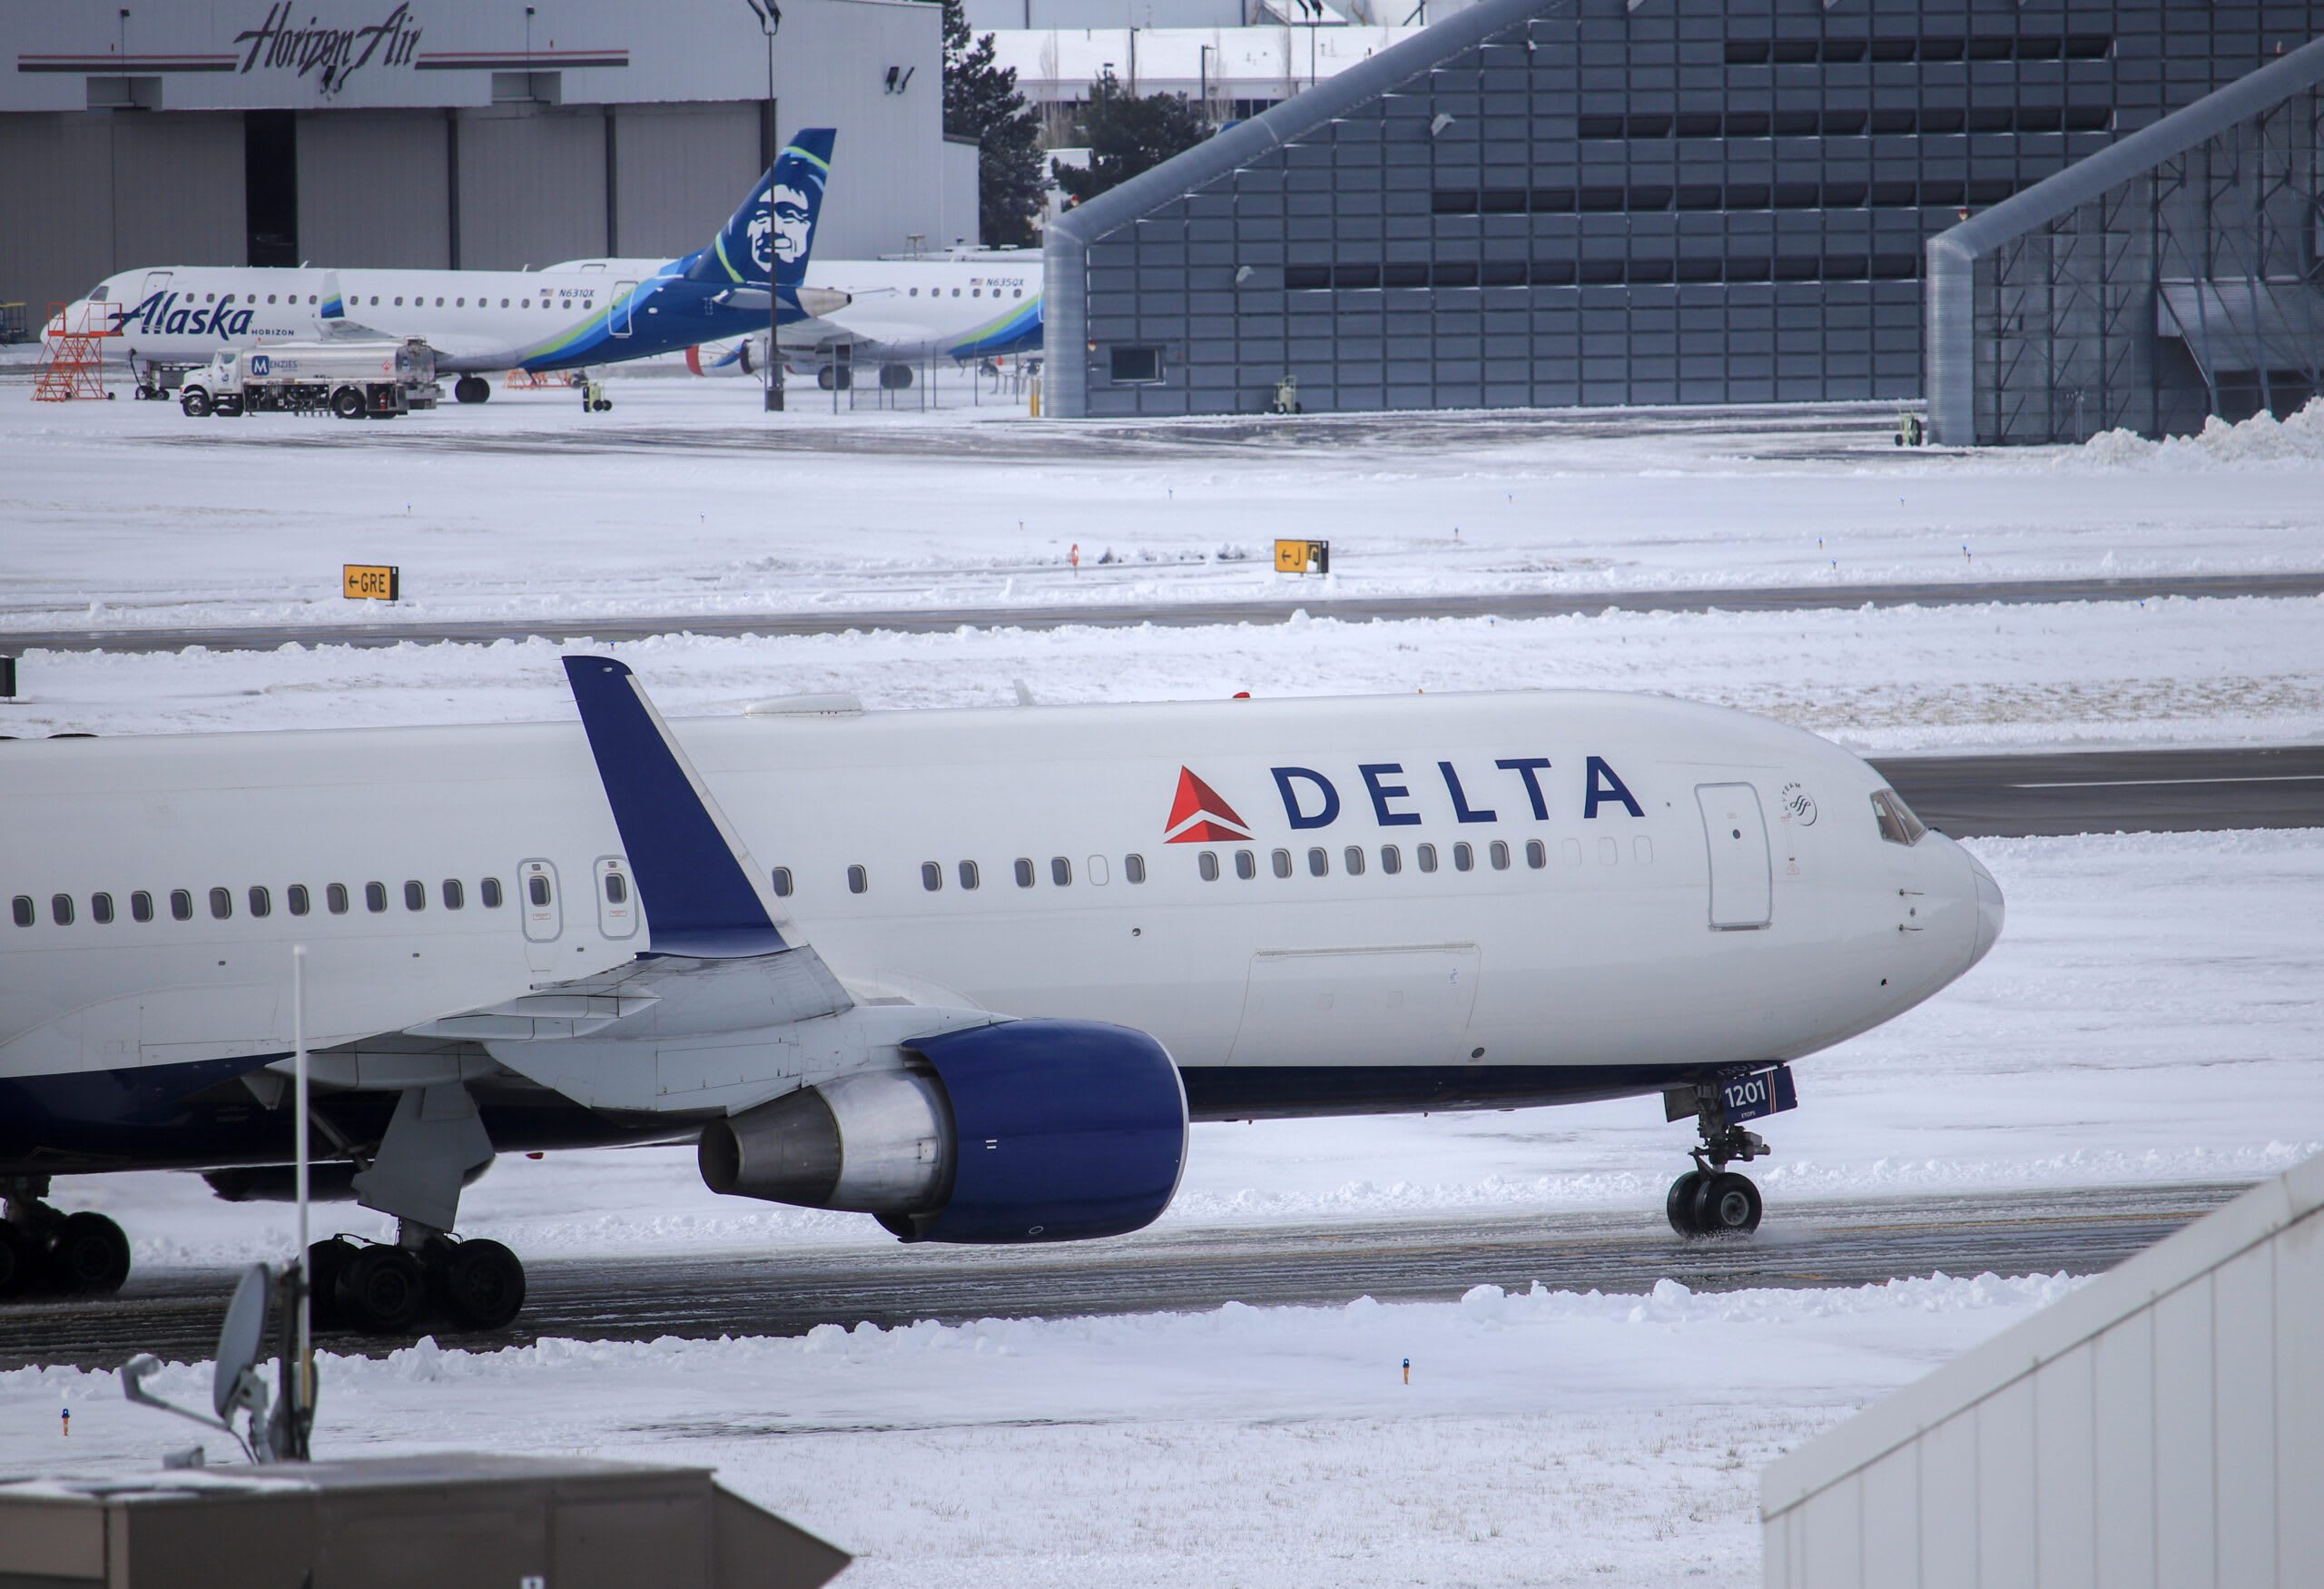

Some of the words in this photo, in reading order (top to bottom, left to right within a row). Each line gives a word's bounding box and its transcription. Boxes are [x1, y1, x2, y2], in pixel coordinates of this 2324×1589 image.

[233, 1, 355, 78] Horizon
[355, 2, 423, 69] Air
[986, 278, 1024, 287] N635QX
[559, 289, 596, 298] N631QX
[107, 290, 255, 341] Alaska
[251, 329, 295, 337] HORIZON
[1294, 546, 1301, 567] J
[360, 572, 386, 593] GRE
[1270, 755, 1646, 830] DELTA
[1725, 1080, 1767, 1108] 1201
[1741, 1110, 1757, 1119] ETOPS
